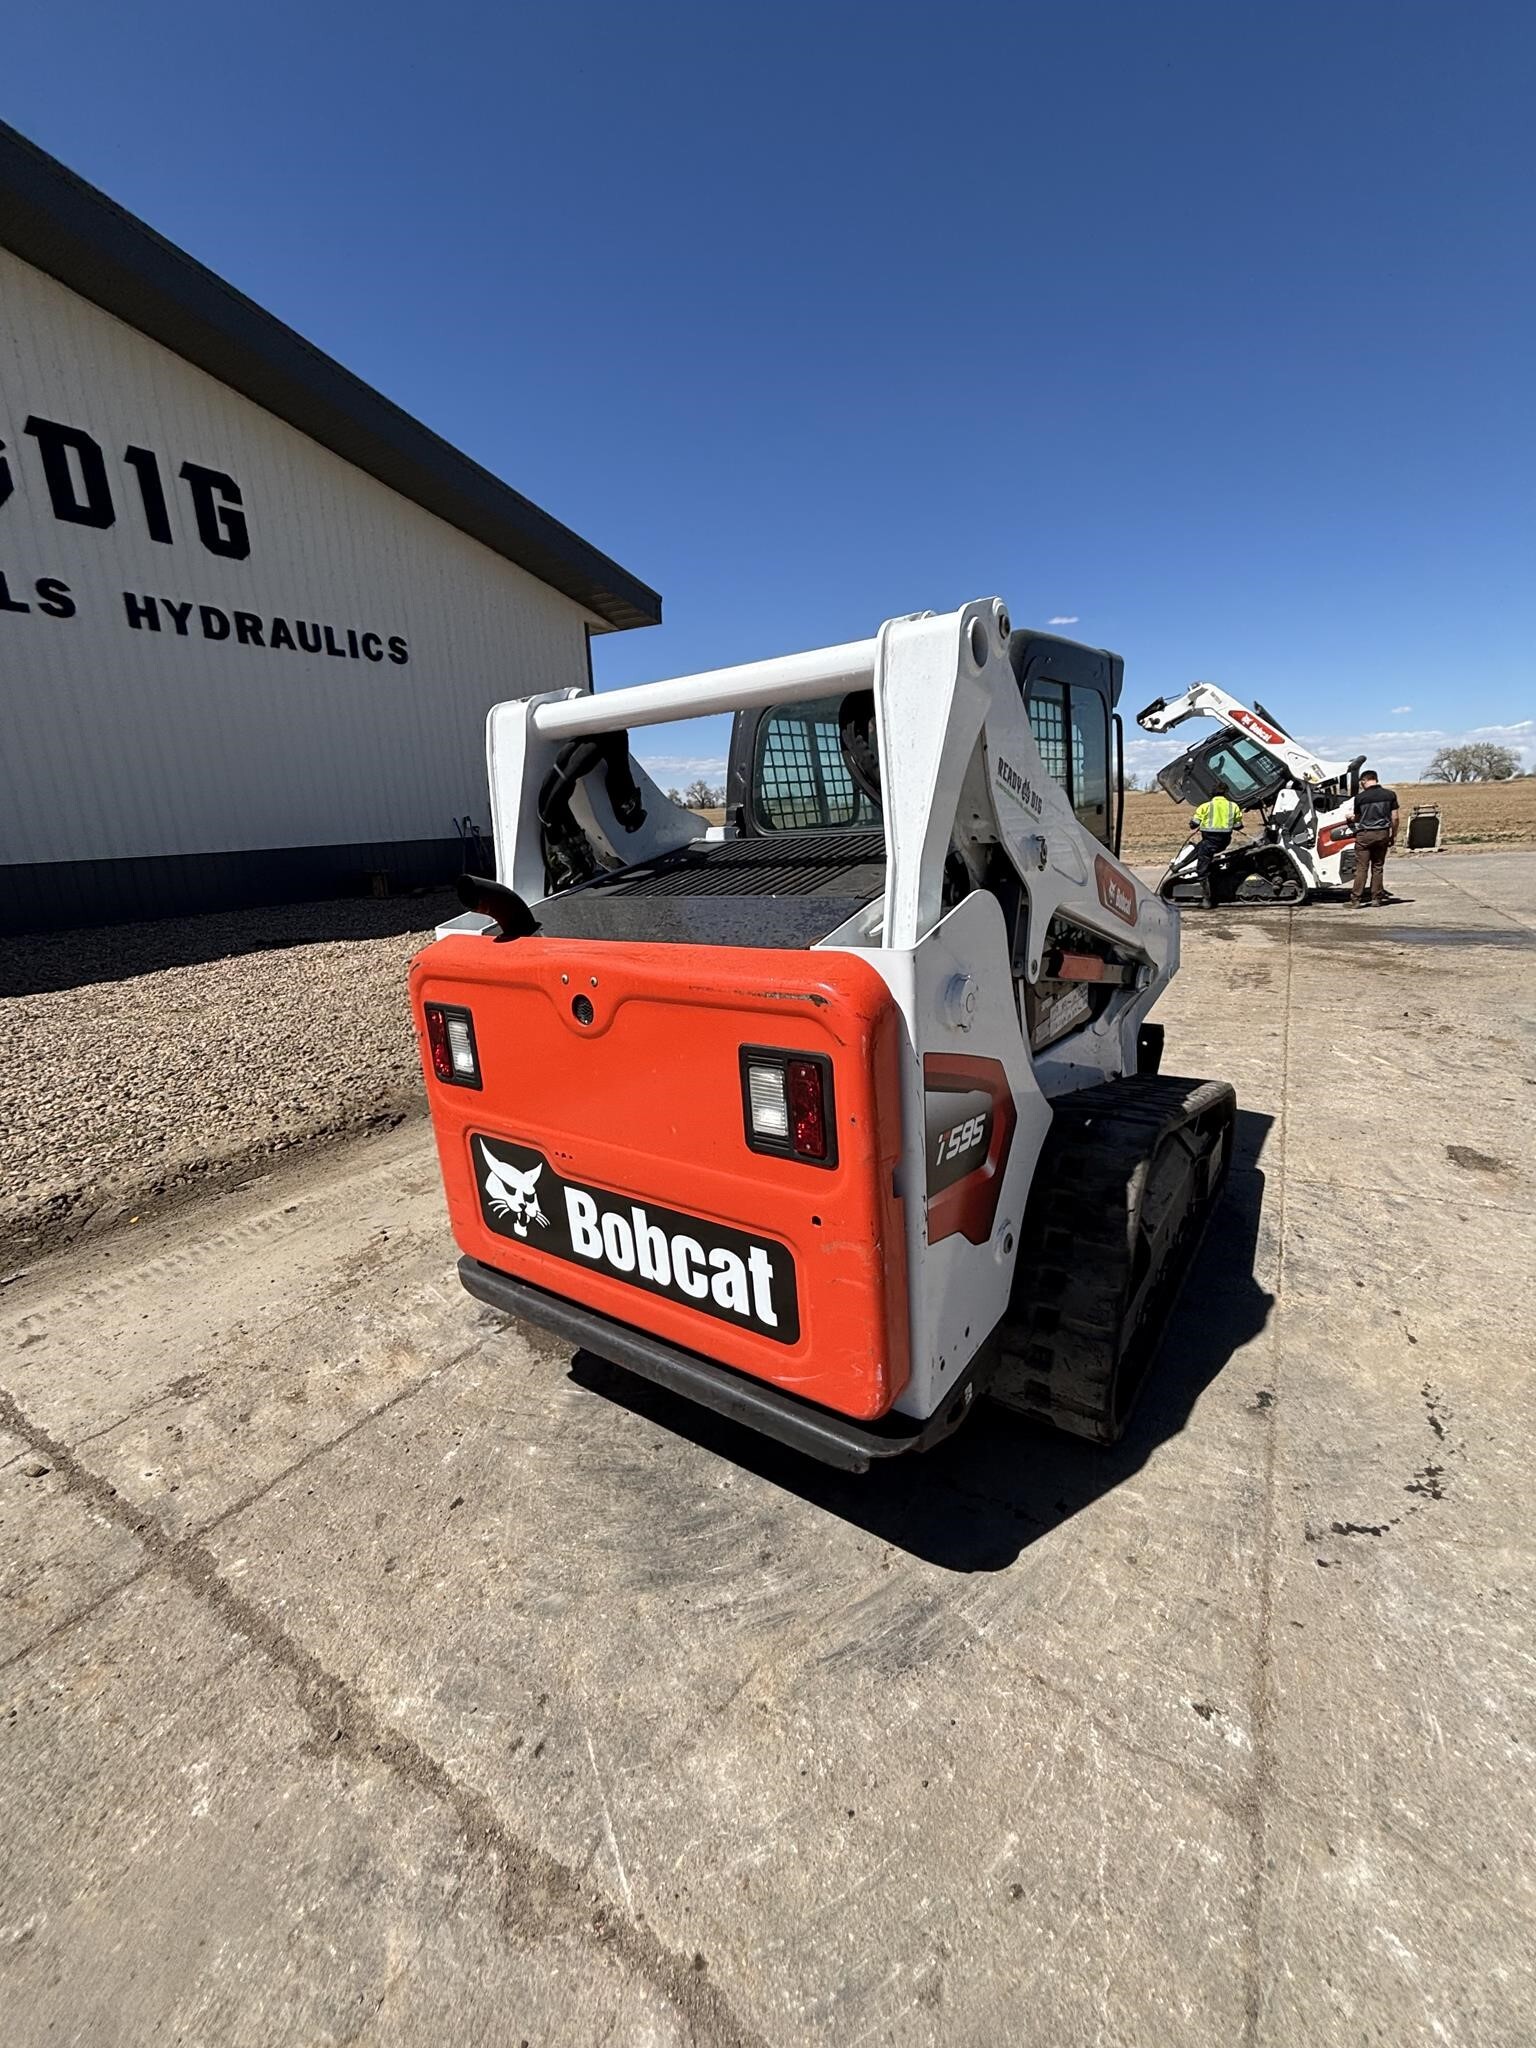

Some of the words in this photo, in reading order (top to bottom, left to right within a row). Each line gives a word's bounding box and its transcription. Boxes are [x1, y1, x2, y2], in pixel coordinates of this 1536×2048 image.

[122, 591, 409, 665] HYDRAULICS
[998, 756, 1022, 794] READY
[563, 1185, 778, 1327] Bobcat
